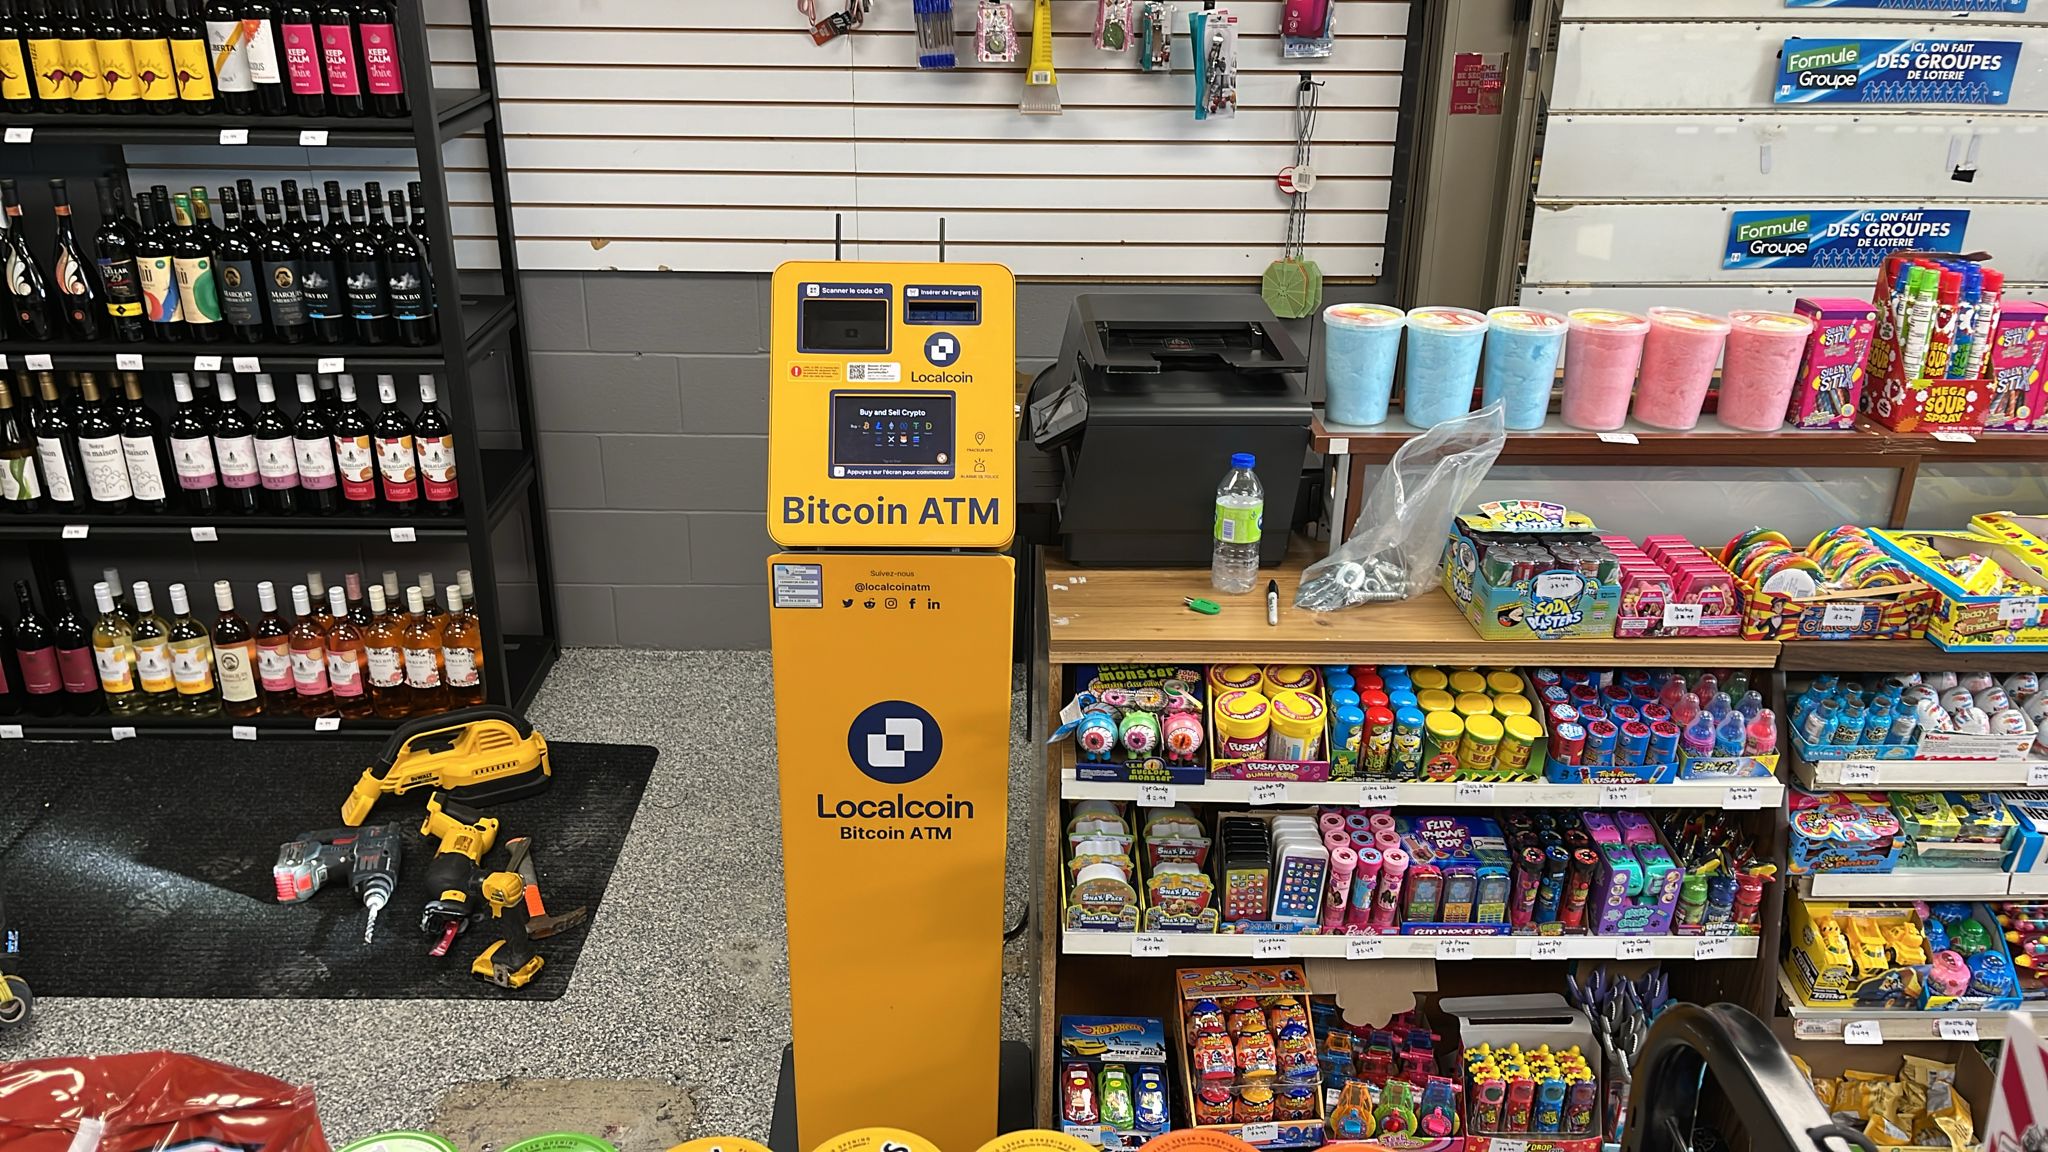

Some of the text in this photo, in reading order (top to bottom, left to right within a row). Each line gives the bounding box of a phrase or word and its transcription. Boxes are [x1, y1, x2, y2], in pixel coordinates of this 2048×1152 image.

[1910, 43, 1974, 54] ICI, ON FAIT
[1789, 48, 1858, 70] Formule
[1876, 54, 2002, 70] DES GROUPES
[1799, 71, 1857, 88] Groupe
[1908, 70, 1964, 80] DE LOTERIE
[1860, 212, 1923, 222] ICI, ON FAIT
[1740, 220, 1808, 240] Formule
[1827, 223, 1950, 238] DES GROUPES
[1858, 238, 1914, 247] DE LOTERIE
[1750, 241, 1808, 258] Groupe
[911, 372, 973, 383] Localcoin
[1932, 386, 1967, 397] MEGA
[1924, 396, 1966, 414] SOUR
[901, 409, 926, 417] Crypto
[1924, 412, 1964, 424] SPRAY
[783, 495, 999, 525] Bitcoin ATM
[854, 582, 930, 593] @localcoinatm
[1537, 599, 1572, 616] SODA
[1527, 611, 1583, 630] BLASTERS
[1960, 610, 1988, 622] Teddy
[1966, 620, 2001, 634] Friends
[1098, 667, 1176, 682] monster
[1229, 742, 1258, 752] PUSH
[1247, 762, 1300, 772] PUSH POP
[1246, 772, 1276, 780] GUMMY
[1152, 786, 1168, 794] Candy
[817, 793, 974, 819] Localcoin
[1426, 820, 1453, 830] FLIP
[840, 827, 952, 840] Bitcoin ATM
[1422, 829, 1466, 841] PHONE
[1436, 838, 1462, 849] POP
[1160, 887, 1200, 896] SNAX PACK
[1250, 922, 1294, 930] MI-PHNE
[1345, 924, 1378, 935] Barbie
[1092, 1024, 1141, 1035] HOT WHEELS
